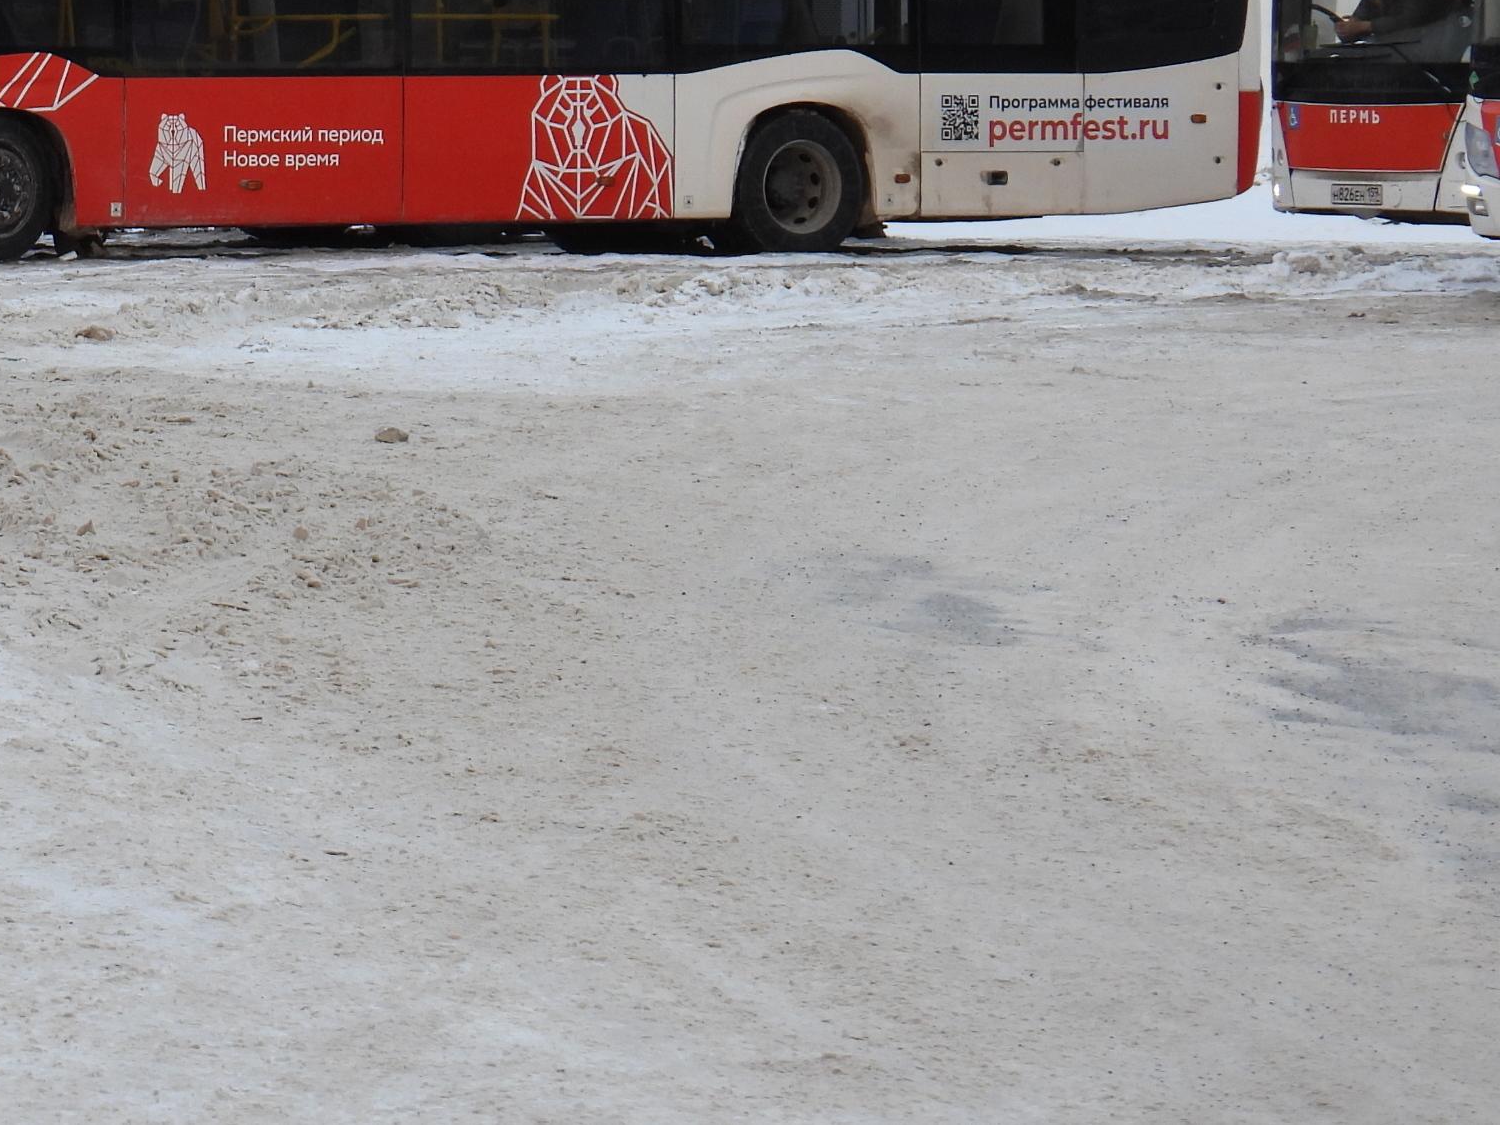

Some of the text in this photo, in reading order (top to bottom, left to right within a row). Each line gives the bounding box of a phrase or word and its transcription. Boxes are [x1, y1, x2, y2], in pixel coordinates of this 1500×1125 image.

[989, 94, 1169, 112] Программа фестиваля
[1329, 109, 1380, 124] ПЕРМЬ
[223, 125, 384, 146] Пермский период
[989, 112, 1169, 148] permfest.ru
[223, 149, 340, 170] Новое время
